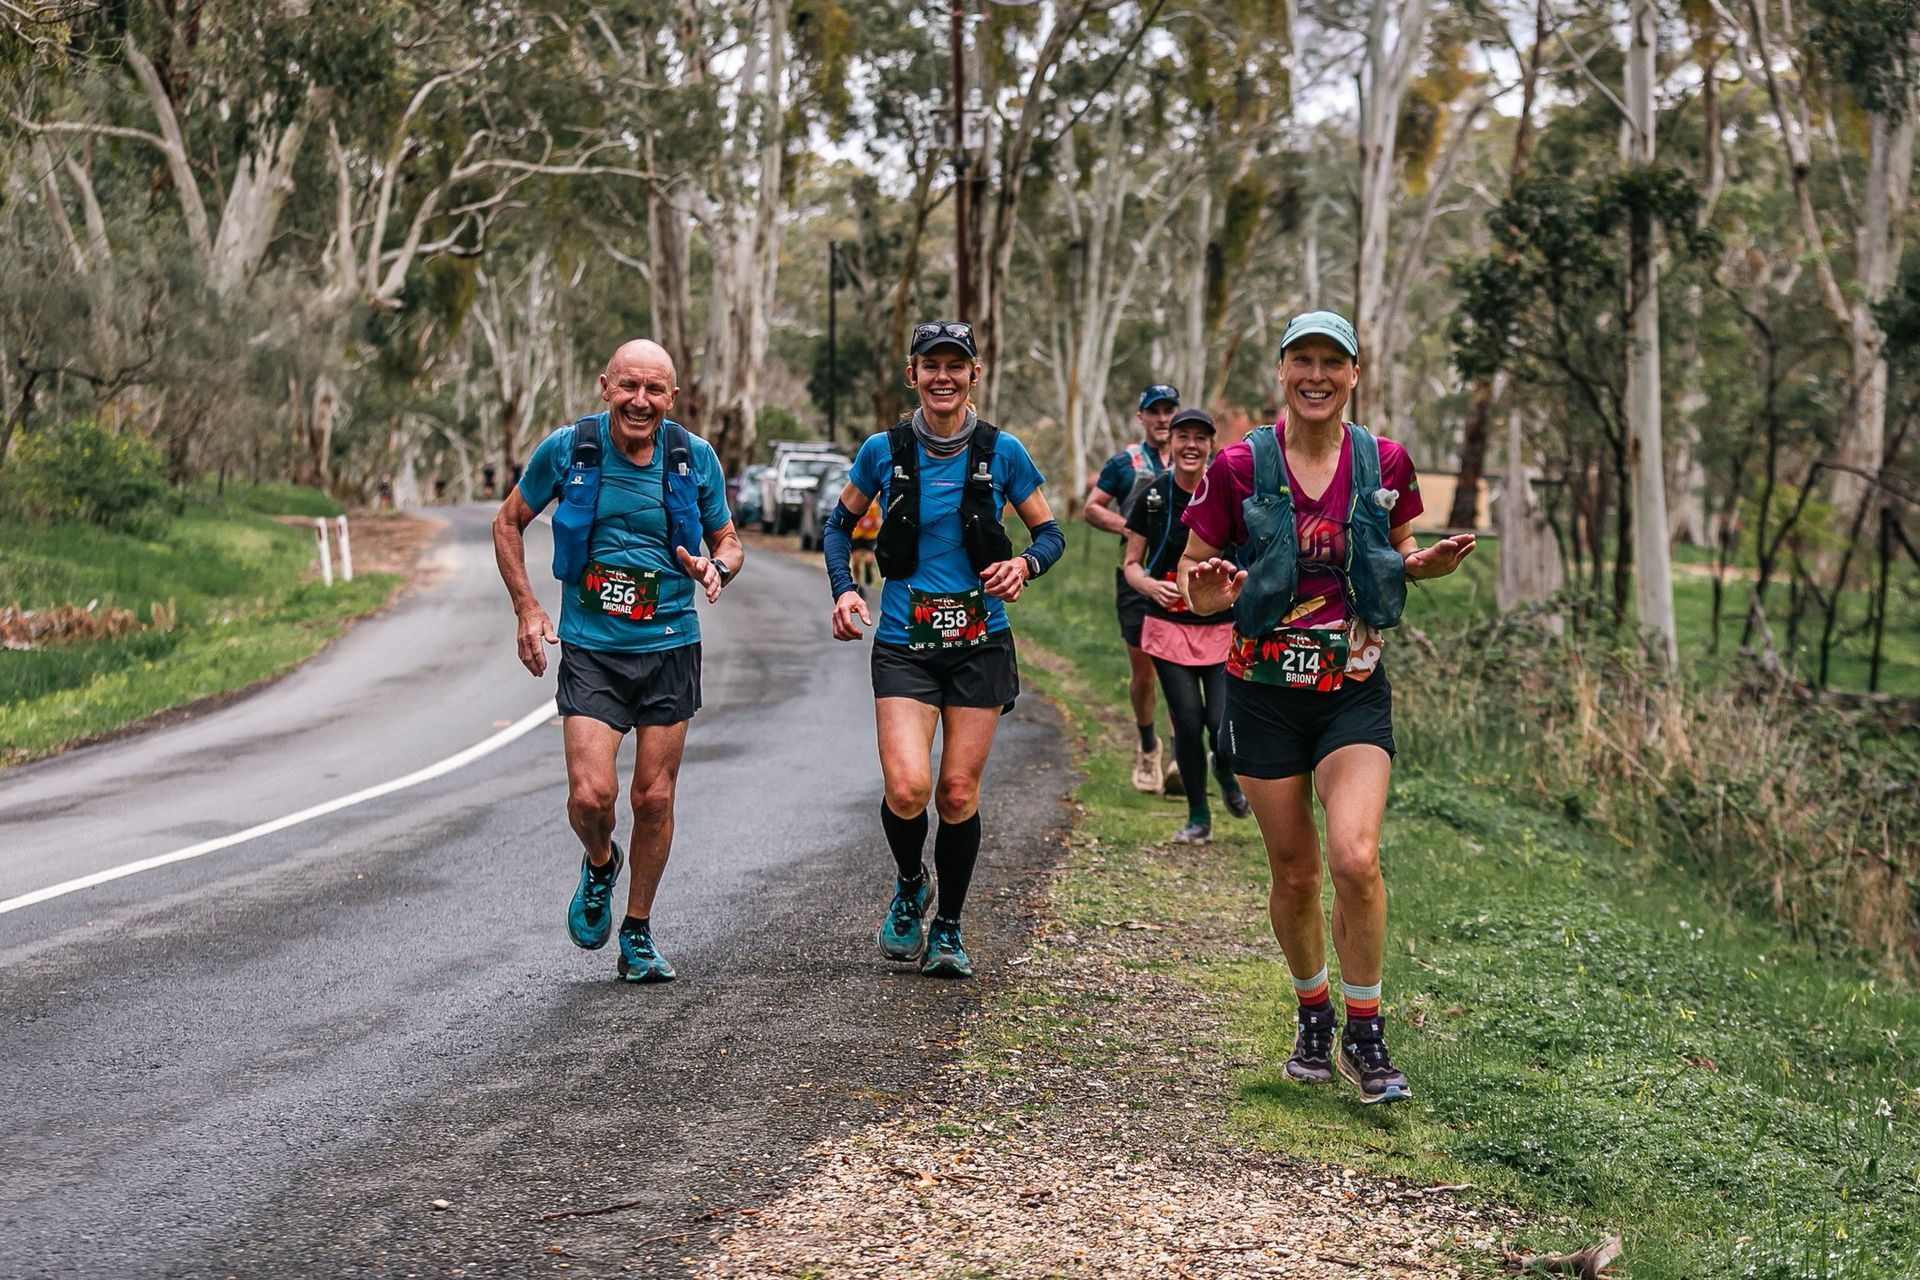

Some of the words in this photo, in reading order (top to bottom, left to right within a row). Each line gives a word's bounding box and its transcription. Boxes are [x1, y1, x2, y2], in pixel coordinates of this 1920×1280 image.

[600, 582, 635, 604] 256
[603, 601, 632, 614] MICHAEL
[932, 610, 967, 628] 258
[942, 629, 959, 637] HEIDI
[1282, 650, 1320, 673] 214
[1286, 672, 1317, 684] BRIONY
